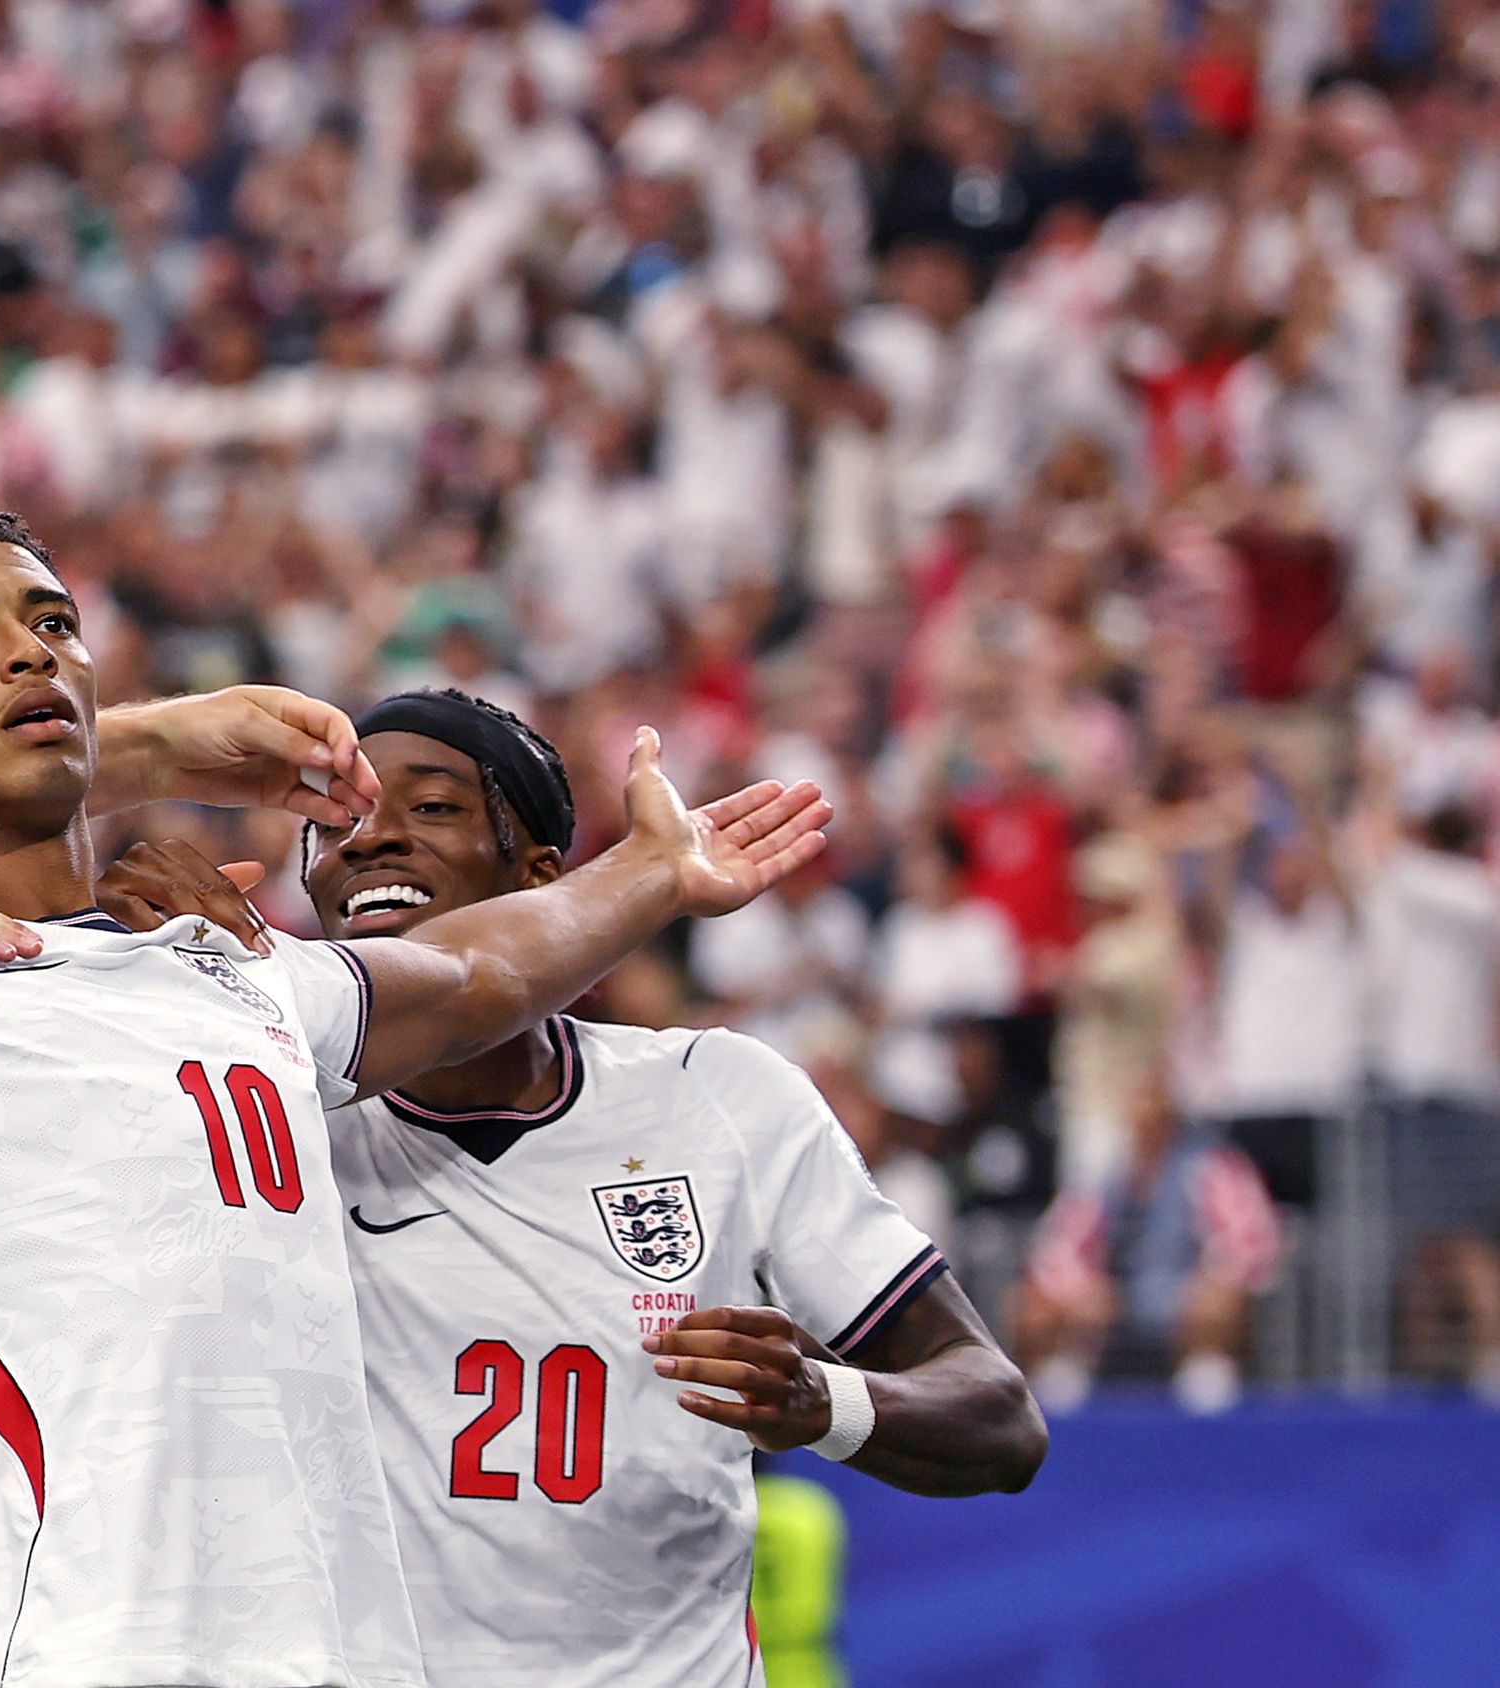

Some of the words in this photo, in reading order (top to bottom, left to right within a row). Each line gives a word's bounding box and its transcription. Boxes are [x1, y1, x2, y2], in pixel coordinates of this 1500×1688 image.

[176, 1059, 305, 1214] 10
[632, 1292, 697, 1312] CROATIA
[449, 1339, 608, 1504] 20
